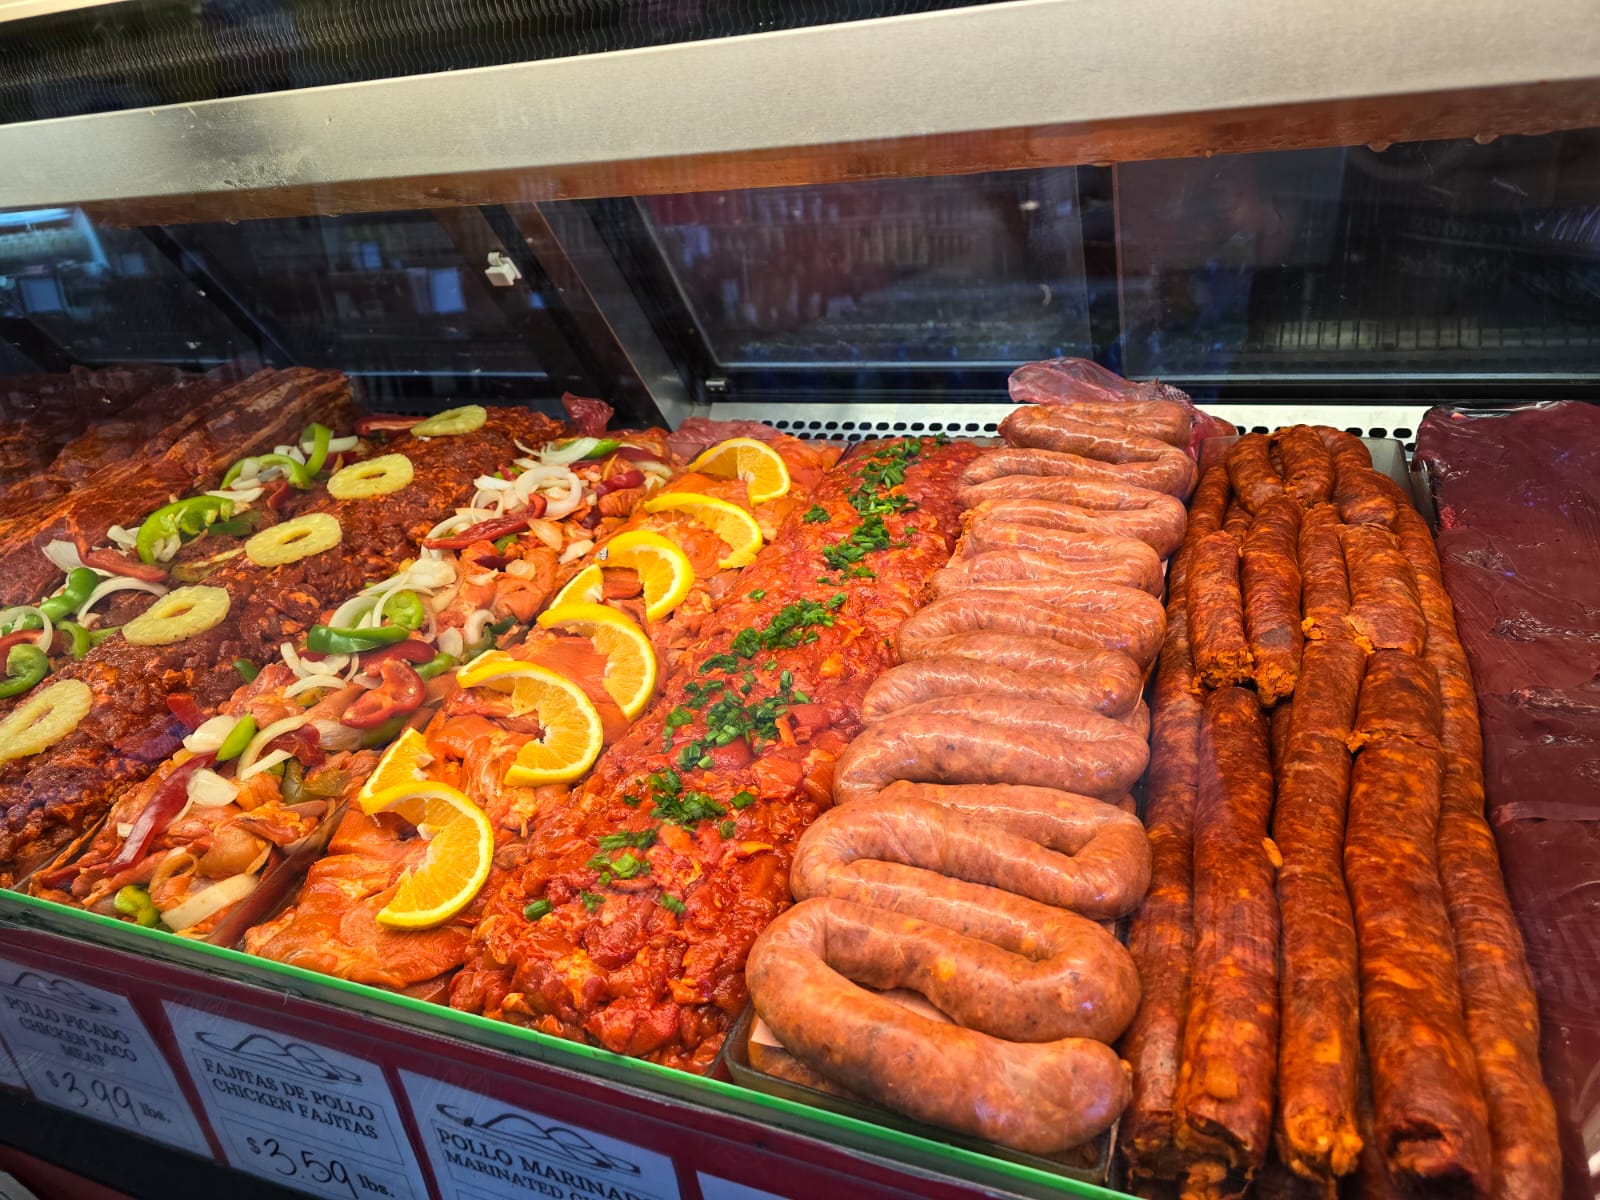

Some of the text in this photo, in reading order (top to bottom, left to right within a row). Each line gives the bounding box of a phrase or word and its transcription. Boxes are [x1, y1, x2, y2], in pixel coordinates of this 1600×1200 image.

[89, 1036, 138, 1062] TACO
[203, 1058, 375, 1122] FAJITAS DE POLLO
[212, 1078, 379, 1140] CHICKEN FAJITAS
[436, 1127, 513, 1169] POLLO
[357, 1173, 395, 1197] lbs.
[445, 1149, 564, 1200] MARINATED
